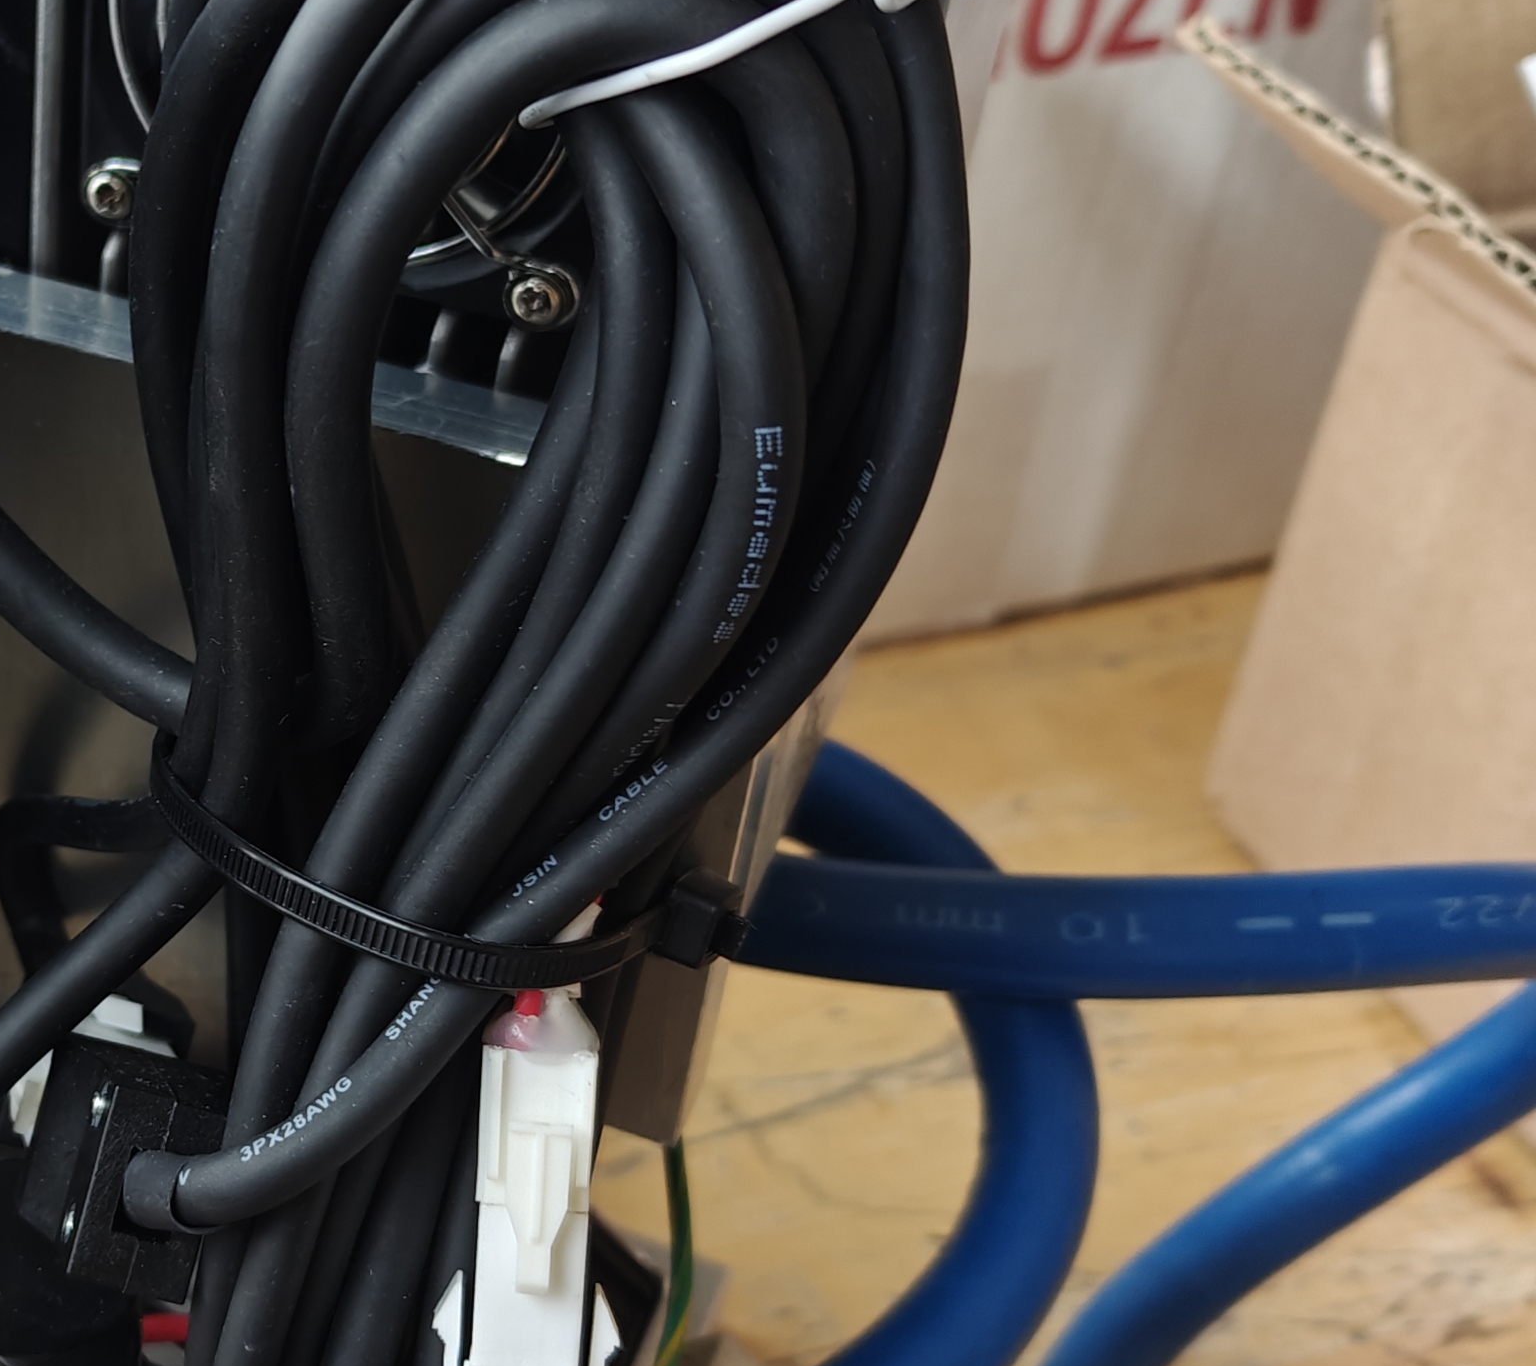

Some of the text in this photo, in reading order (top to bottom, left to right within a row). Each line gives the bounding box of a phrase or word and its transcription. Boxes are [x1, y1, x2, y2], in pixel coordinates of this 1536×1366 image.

[239, 1075, 353, 1162] 3PX28AWG
[512, 854, 558, 898] JSIN
[597, 760, 669, 823] CABLE
[746, 636, 779, 678] LTD
